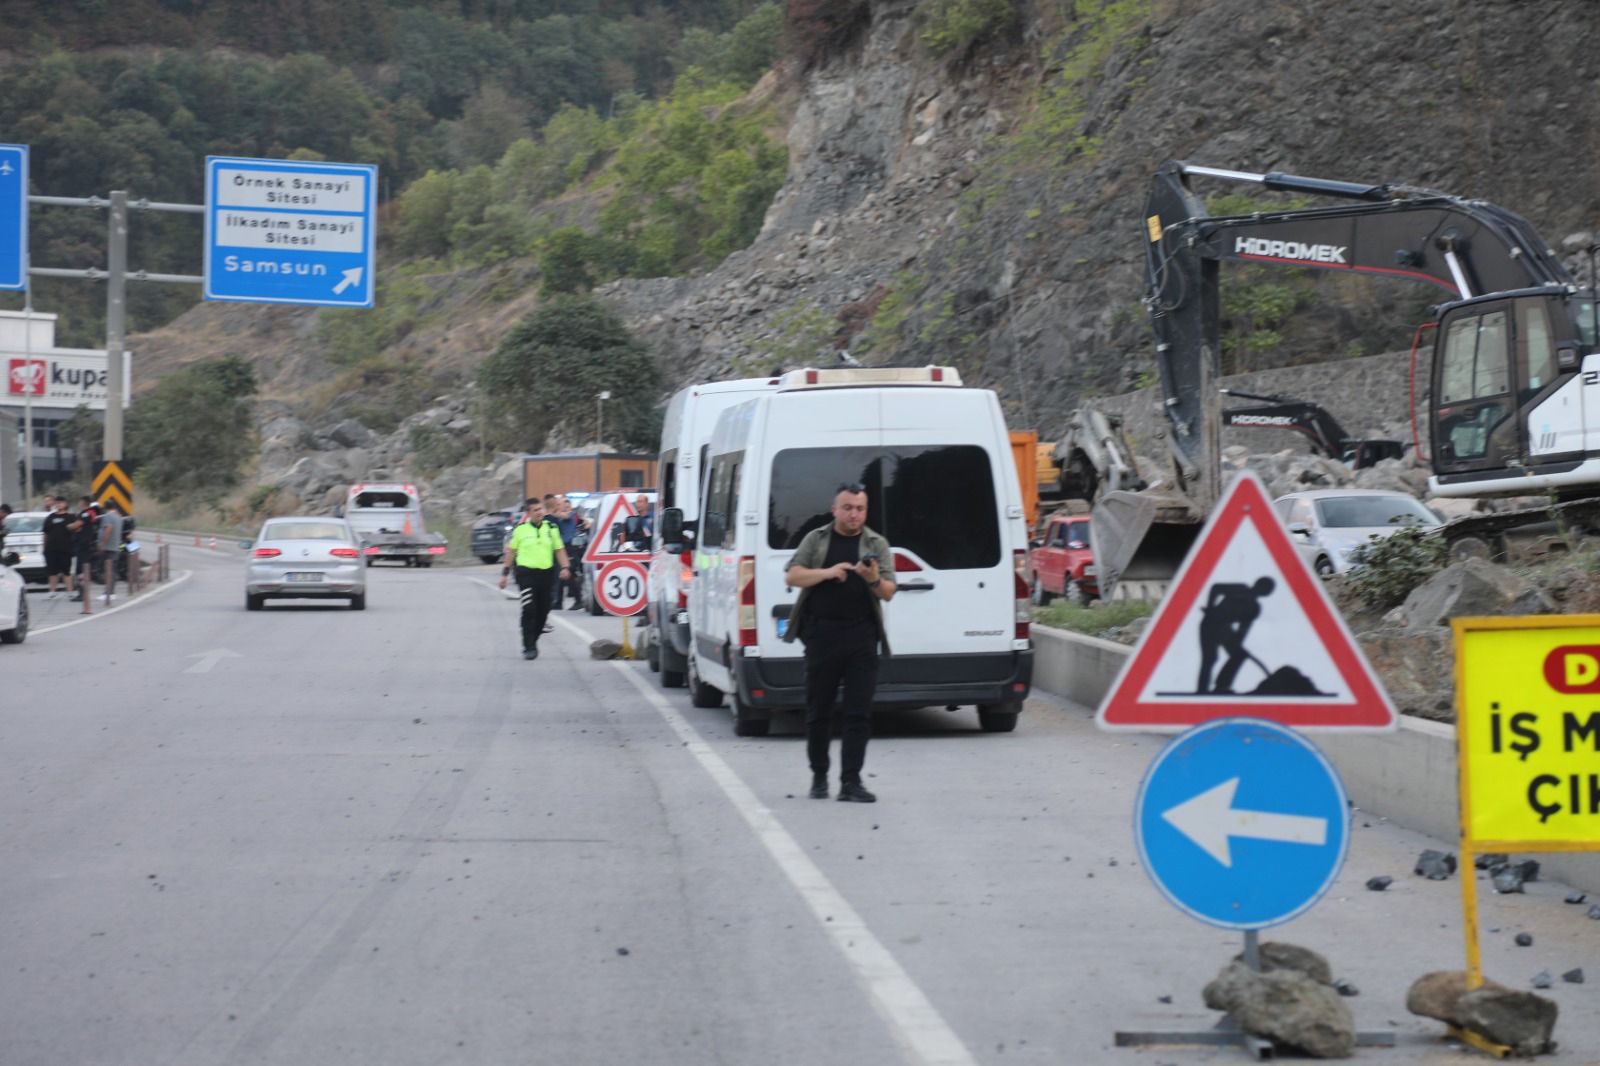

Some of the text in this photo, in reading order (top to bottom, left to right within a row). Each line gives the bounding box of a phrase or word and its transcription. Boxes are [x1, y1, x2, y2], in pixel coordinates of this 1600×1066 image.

[292, 178, 350, 193] Sanayi
[266, 191, 317, 204] Sitesi
[297, 219, 354, 234] Sanayi
[265, 232, 316, 245] Sitesi
[224, 255, 327, 276] Samsun
[608, 575, 640, 600] 30
[1490, 702, 1541, 762] İŞ
